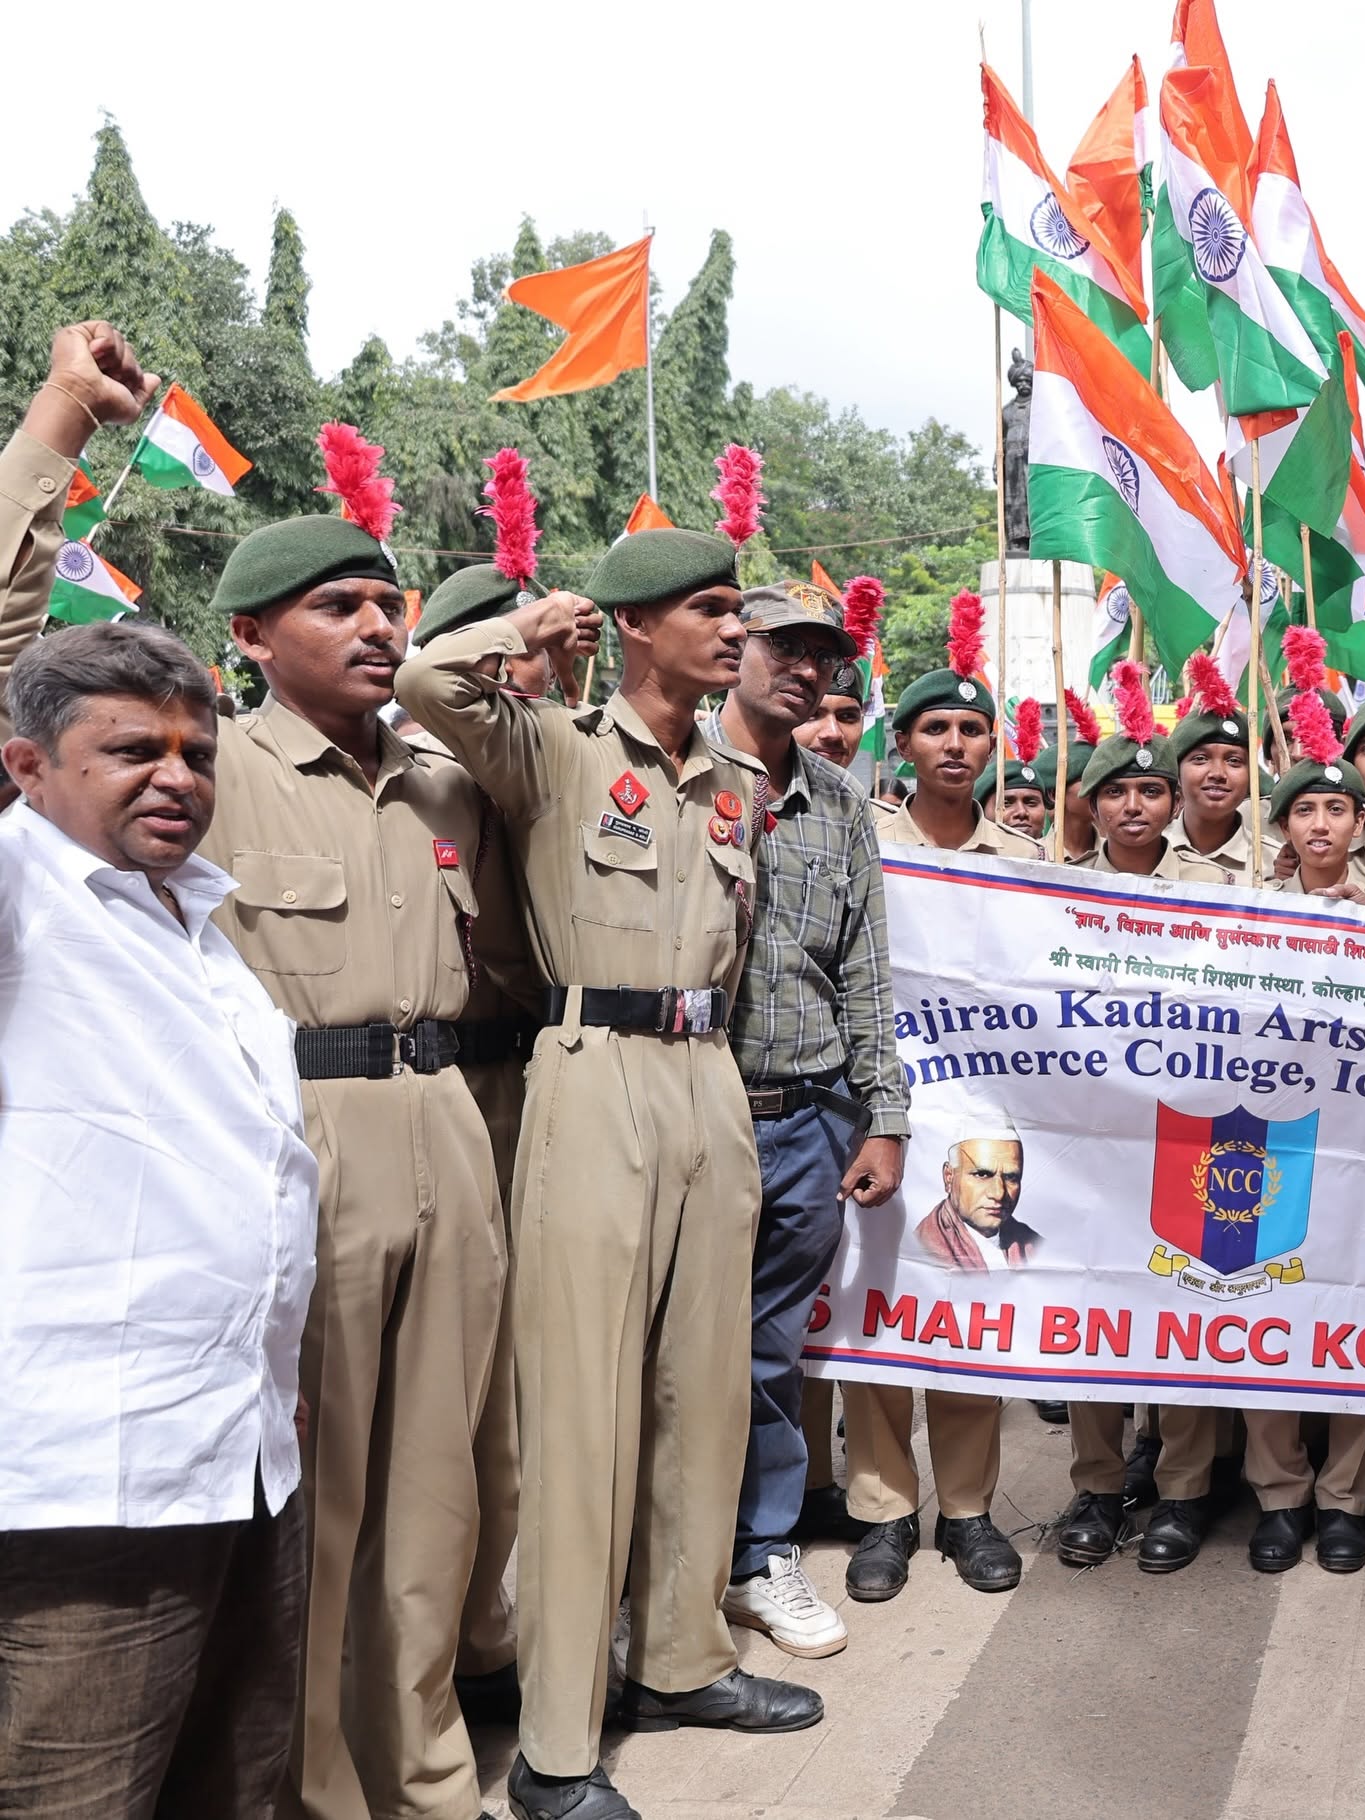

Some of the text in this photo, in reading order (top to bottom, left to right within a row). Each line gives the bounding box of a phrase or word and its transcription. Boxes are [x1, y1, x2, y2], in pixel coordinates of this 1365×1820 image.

[1117, 912, 1164, 937] विज्ञान
[1169, 920, 1211, 942] आणि
[1215, 924, 1281, 950] सुसंस्कार
[1286, 935, 1339, 956] यासाठी
[1048, 946, 1072, 967] श्री
[1075, 950, 1121, 974] स्वामी
[1124, 955, 1199, 985] विवेकानंद
[1202, 964, 1255, 990] शिक्षण
[1258, 972, 1306, 998] संस्था,
[1056, 989, 1241, 1034] Kadam
[1125, 1038, 1316, 1094] College,
[1209, 1167, 1262, 1194] NCC
[862, 1288, 1015, 1352] MAH
[1039, 1305, 1131, 1358] BN
[1156, 1311, 1291, 1365] NCC
